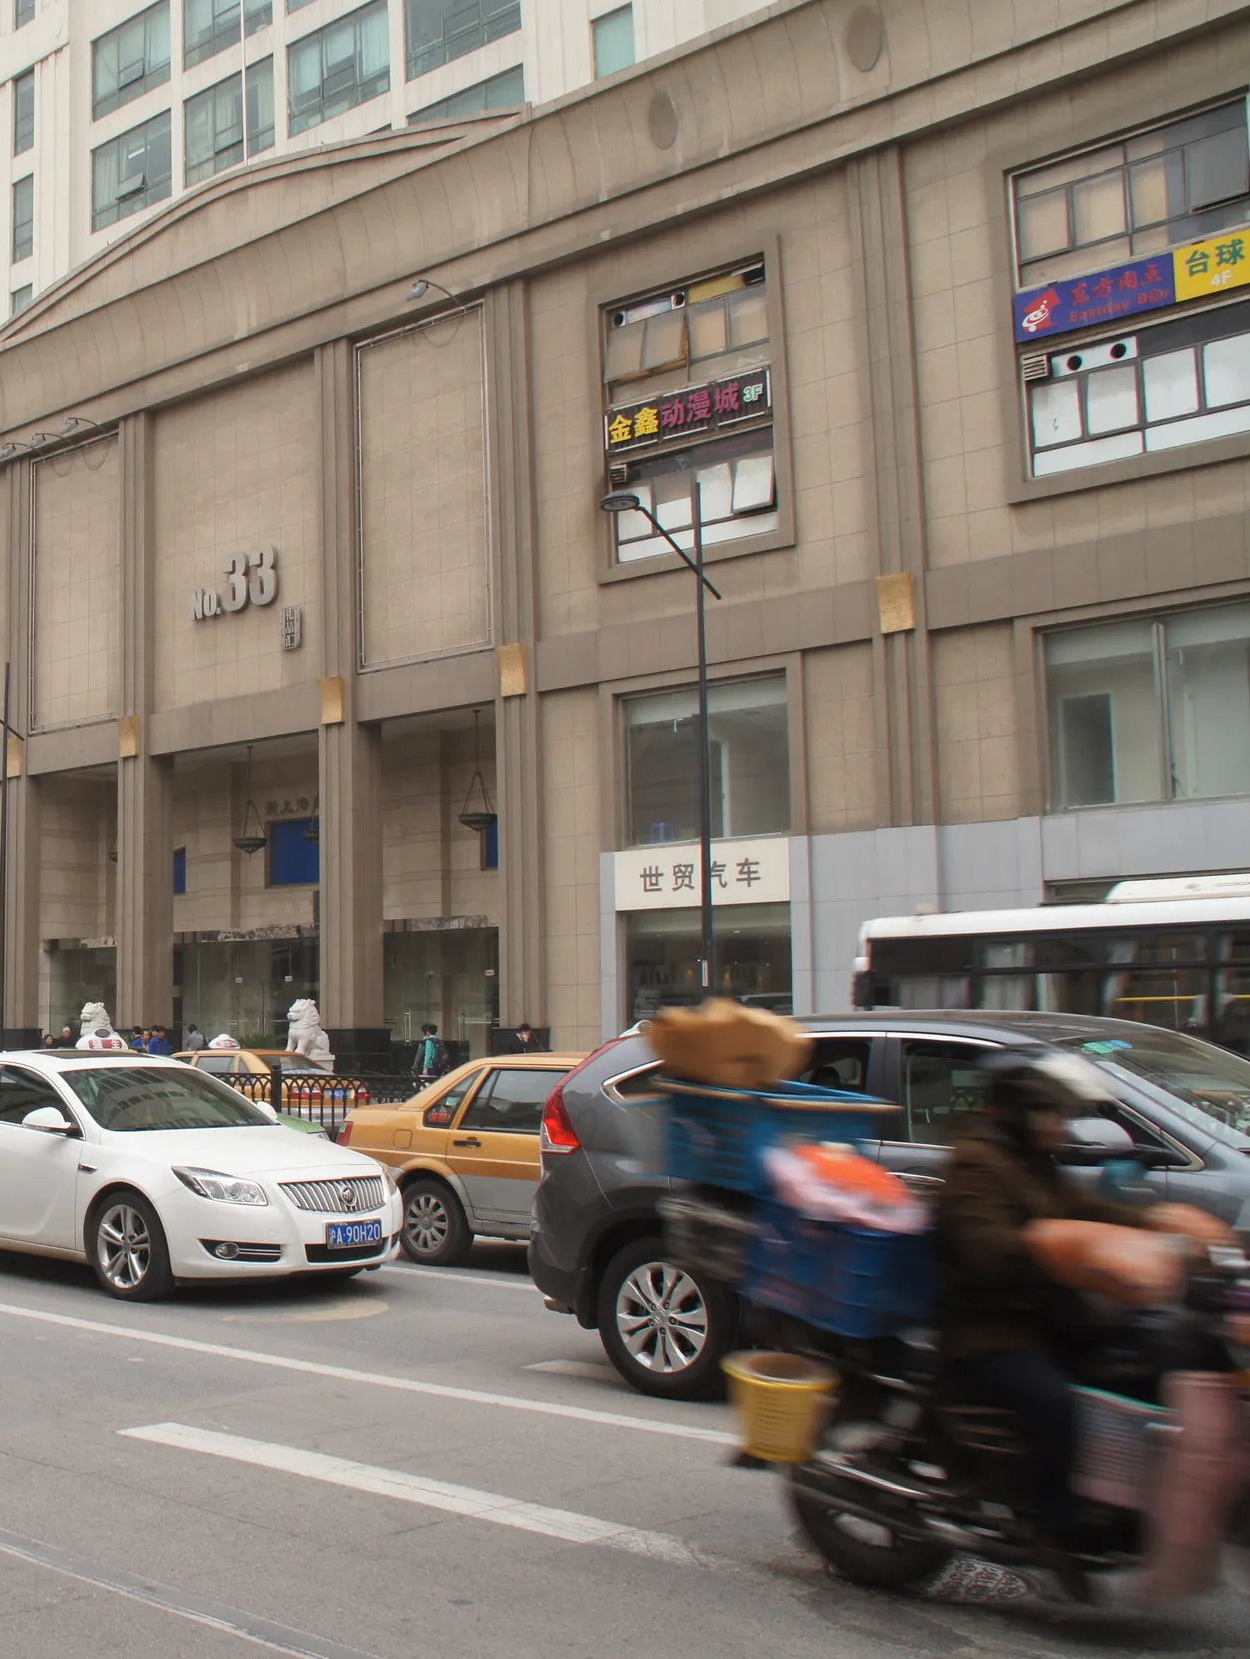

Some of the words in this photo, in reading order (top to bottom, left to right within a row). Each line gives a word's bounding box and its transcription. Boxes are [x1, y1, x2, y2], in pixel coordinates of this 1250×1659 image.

[1185, 238, 1246, 277] 台球
[1211, 269, 1233, 286] 4F
[1069, 301, 1130, 323] Eastday
[608, 382, 740, 444] 金鑫动漫城
[742, 383, 764, 403] 3F
[191, 545, 278, 621] No.33
[640, 858, 761, 892] 世贸汽车
